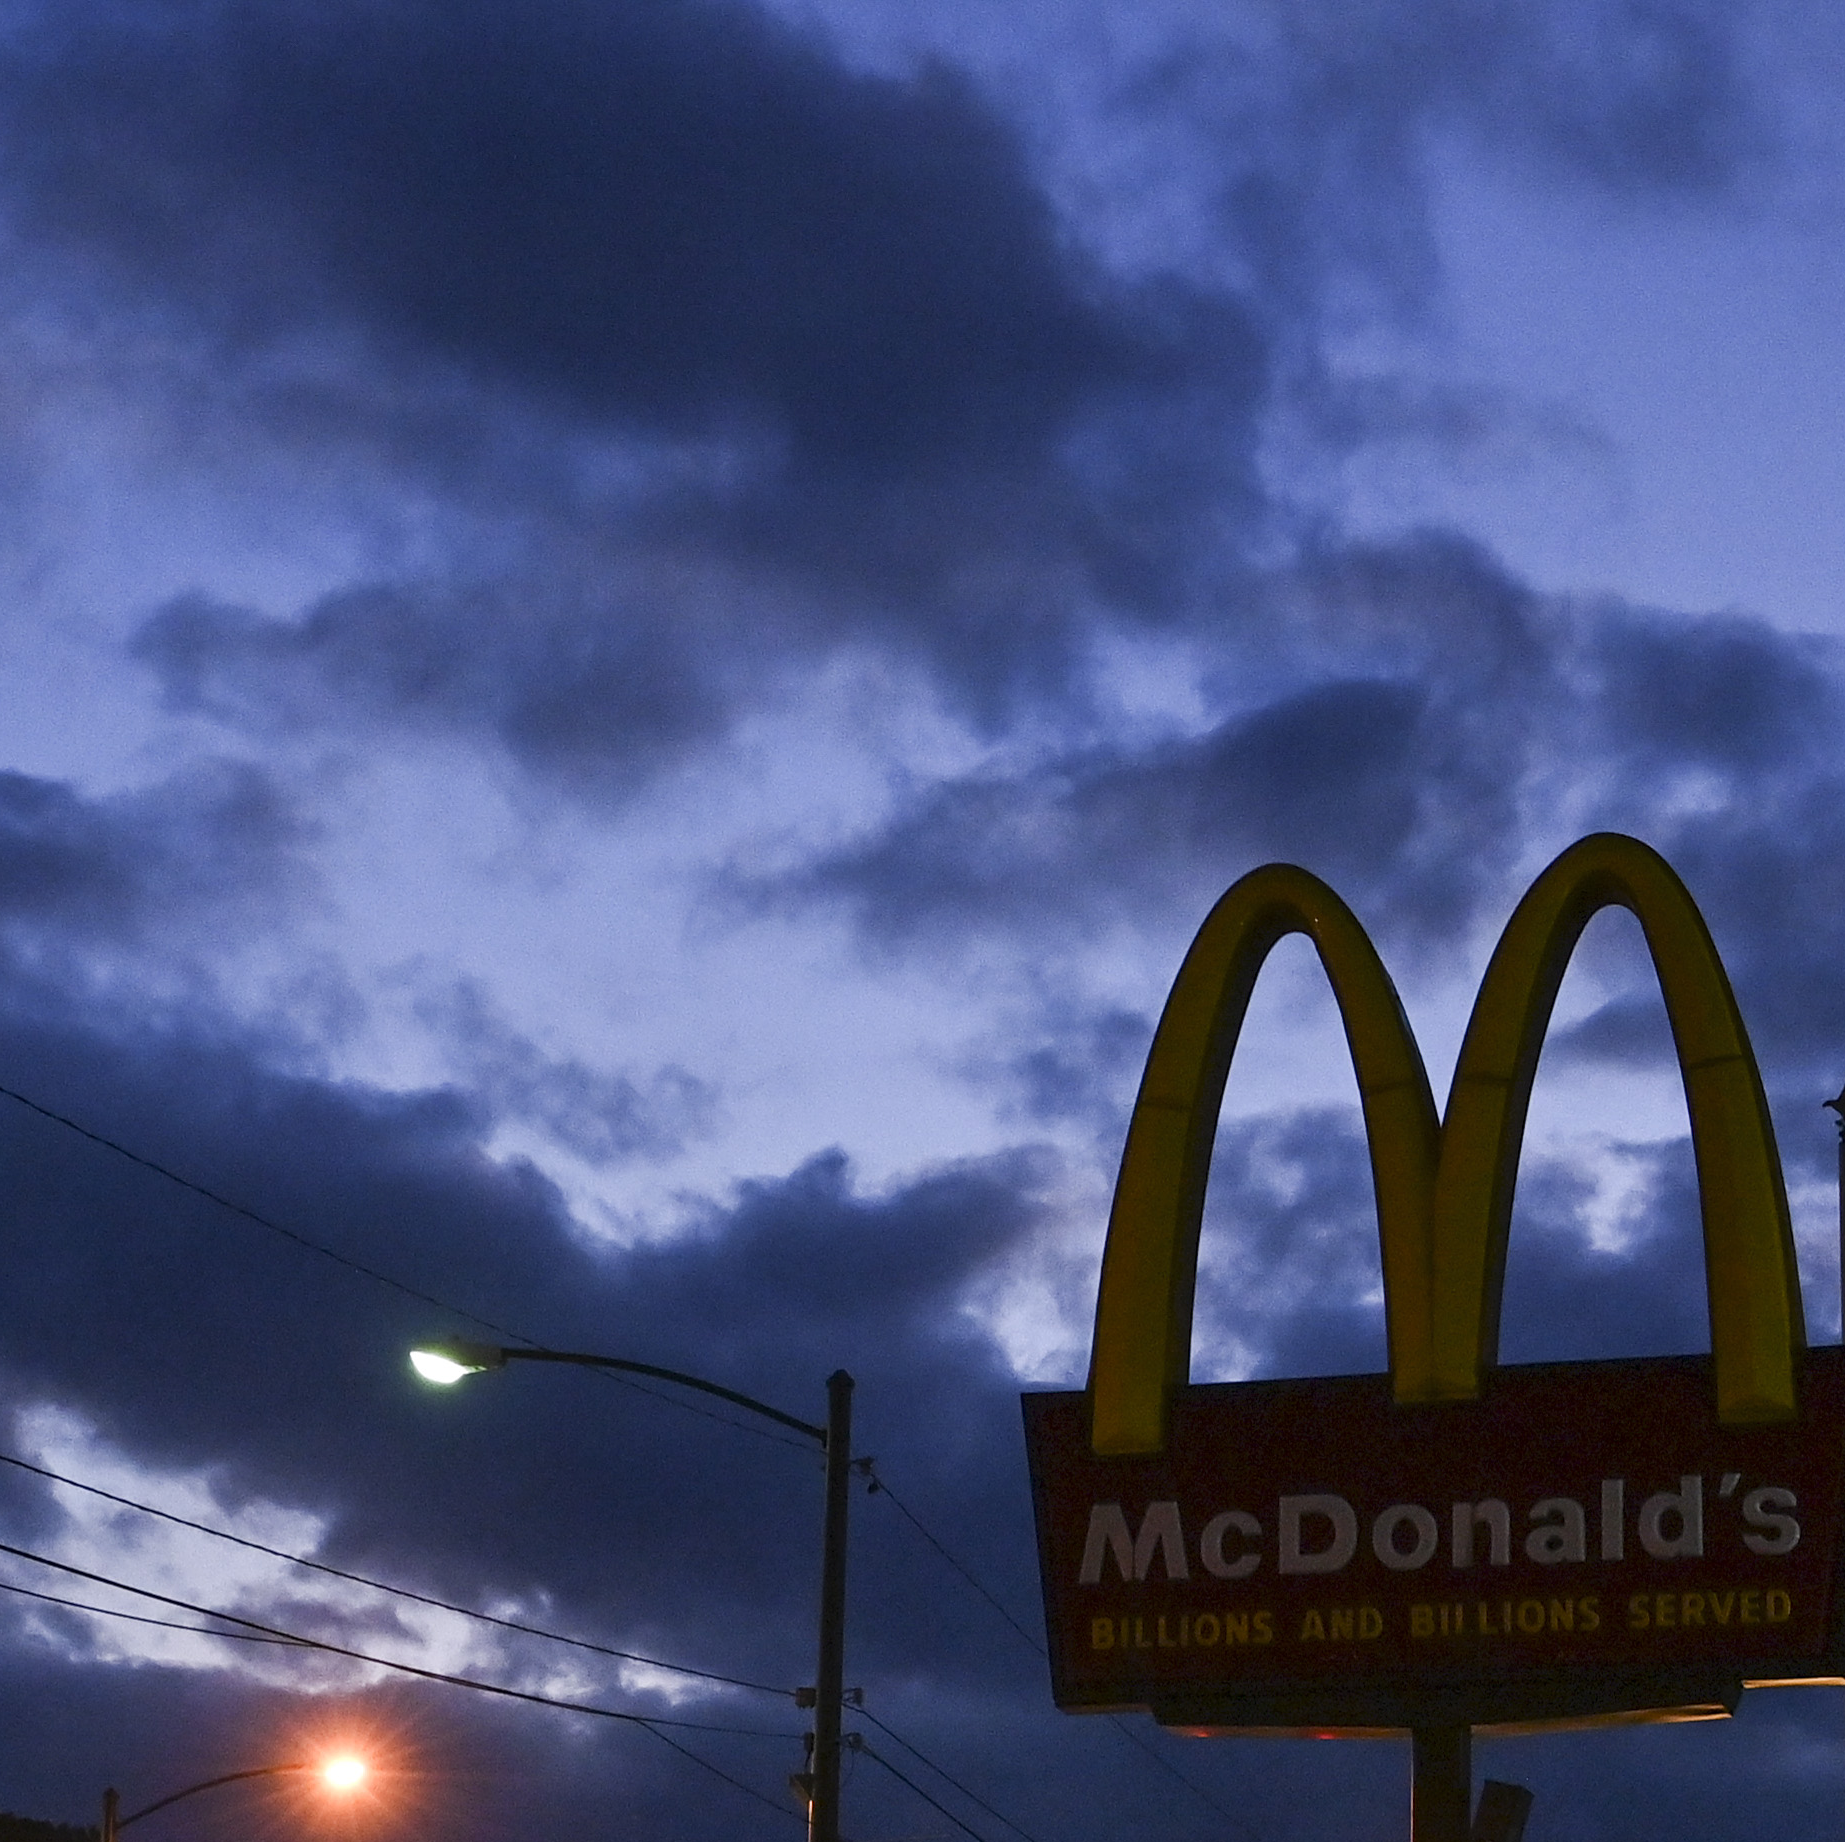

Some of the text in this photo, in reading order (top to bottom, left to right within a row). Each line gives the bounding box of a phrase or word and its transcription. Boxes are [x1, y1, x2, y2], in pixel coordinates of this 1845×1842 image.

[1078, 1472, 1802, 1585] McDonald's
[1091, 1590, 1792, 1651] BILLIONS AND BILLIONS SERVED
